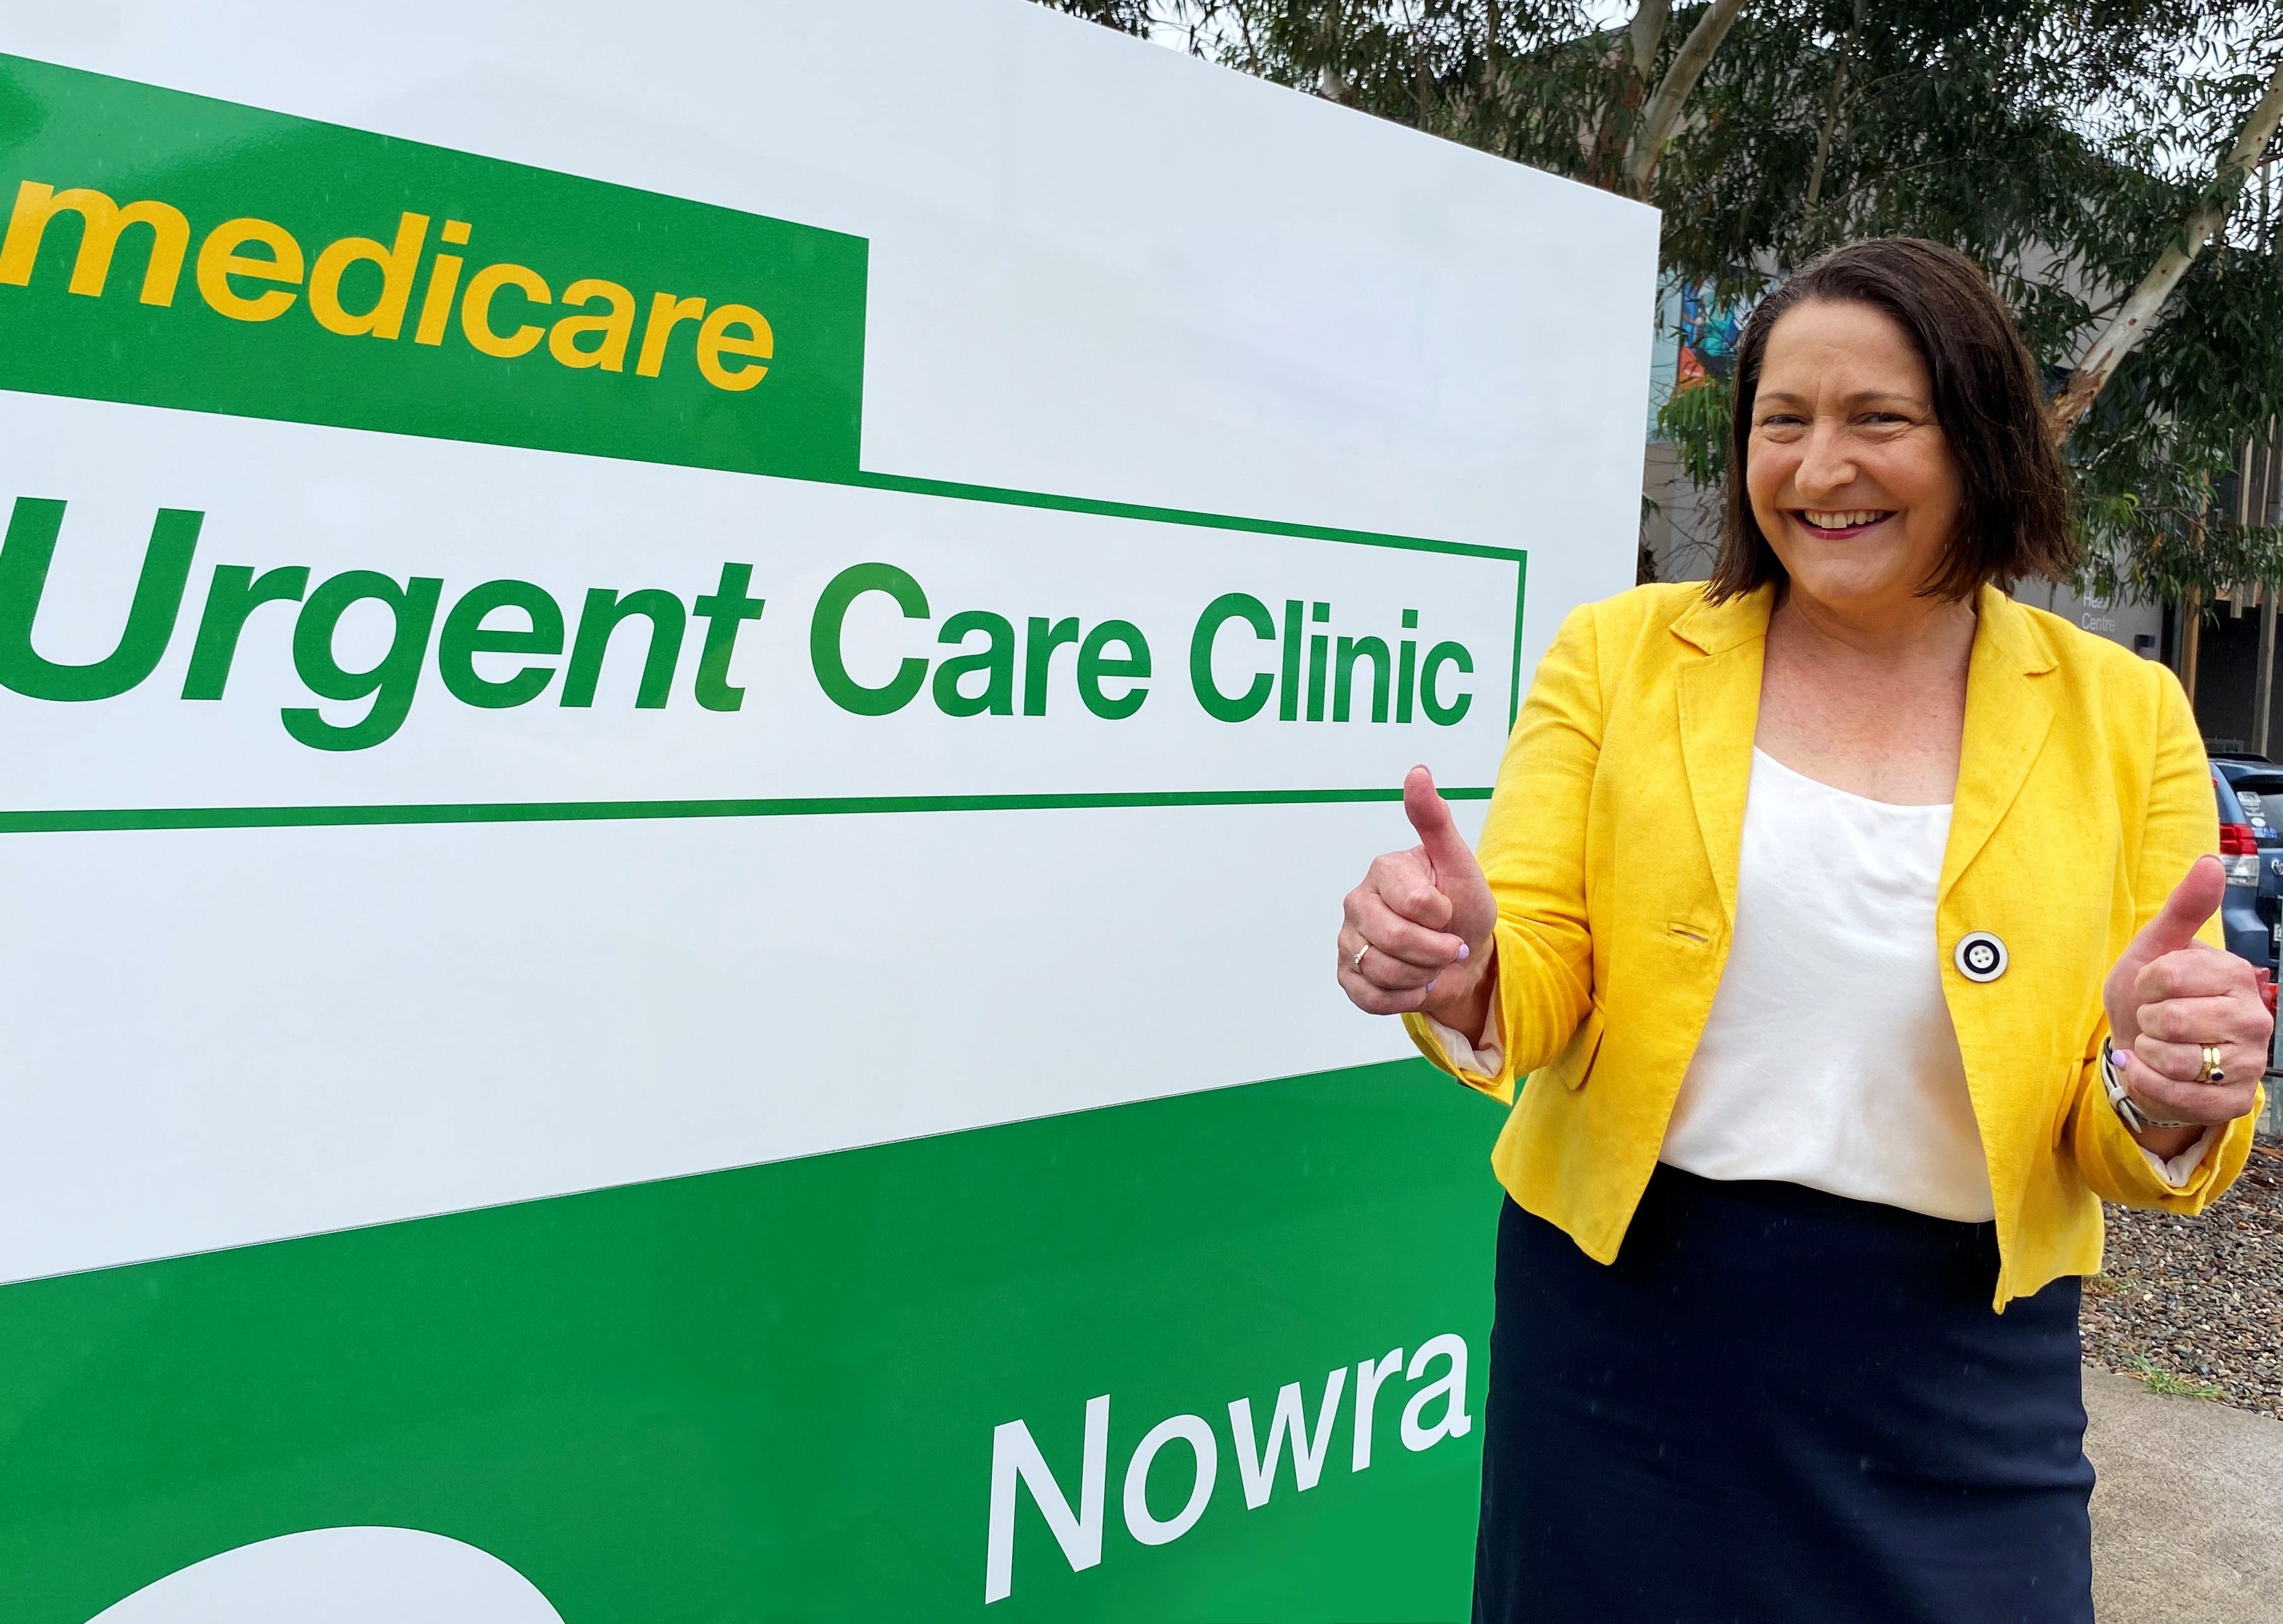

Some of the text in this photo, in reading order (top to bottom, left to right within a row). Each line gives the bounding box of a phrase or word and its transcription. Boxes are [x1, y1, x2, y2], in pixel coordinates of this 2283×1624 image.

[0, 180, 774, 392] medicare
[0, 496, 1475, 751] Urgent Care Clinic
[2082, 612, 2115, 632] Centre
[984, 1333, 1472, 1605] Nowra
